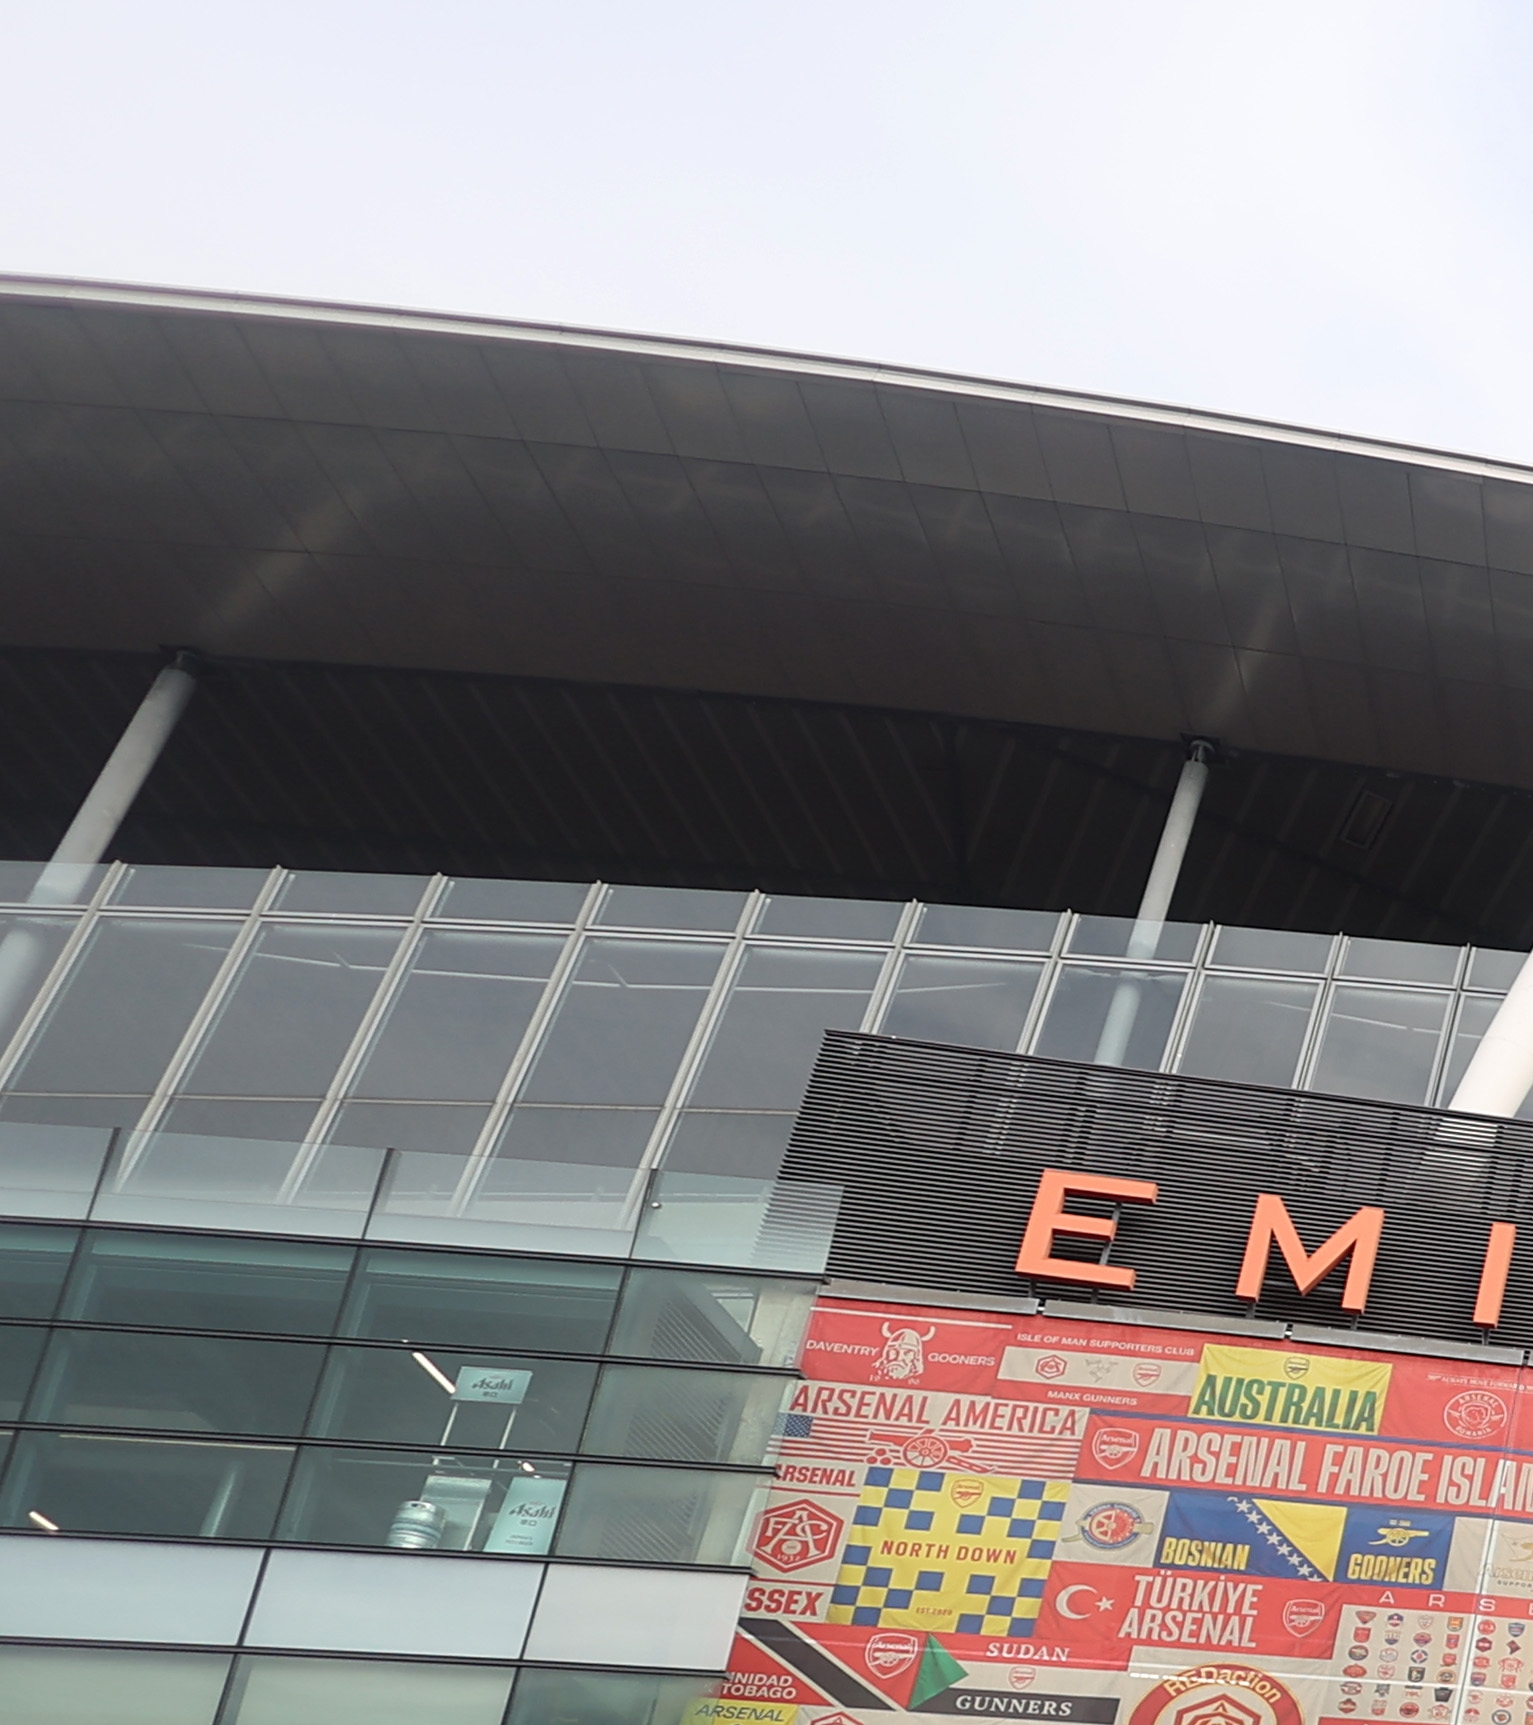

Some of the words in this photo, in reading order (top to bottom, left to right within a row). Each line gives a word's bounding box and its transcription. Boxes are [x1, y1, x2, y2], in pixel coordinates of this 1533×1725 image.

[806, 1339, 881, 1358] DAVENTRY
[927, 1351, 995, 1368] GOONERS
[1016, 1332, 1041, 1344] ISLE
[1045, 1335, 1060, 1346] OF
[1062, 1337, 1086, 1348] MAN
[1090, 1339, 1159, 1353] SUPPORTERS
[1163, 1344, 1195, 1356] CLUB
[789, 1384, 931, 1425] ARSENAL
[942, 1398, 1077, 1436] AMERICA
[1192, 1374, 1378, 1434] AUSTRALIA
[1141, 1429, 1308, 1491] ARSENAL
[1317, 1444, 1433, 1502] FAROE
[880, 1539, 949, 1561] NORTH
[956, 1545, 1017, 1565] DOWN
[1135, 1568, 1263, 1614] TÜRKİYE
[986, 1642, 1070, 1662] SUDAN
